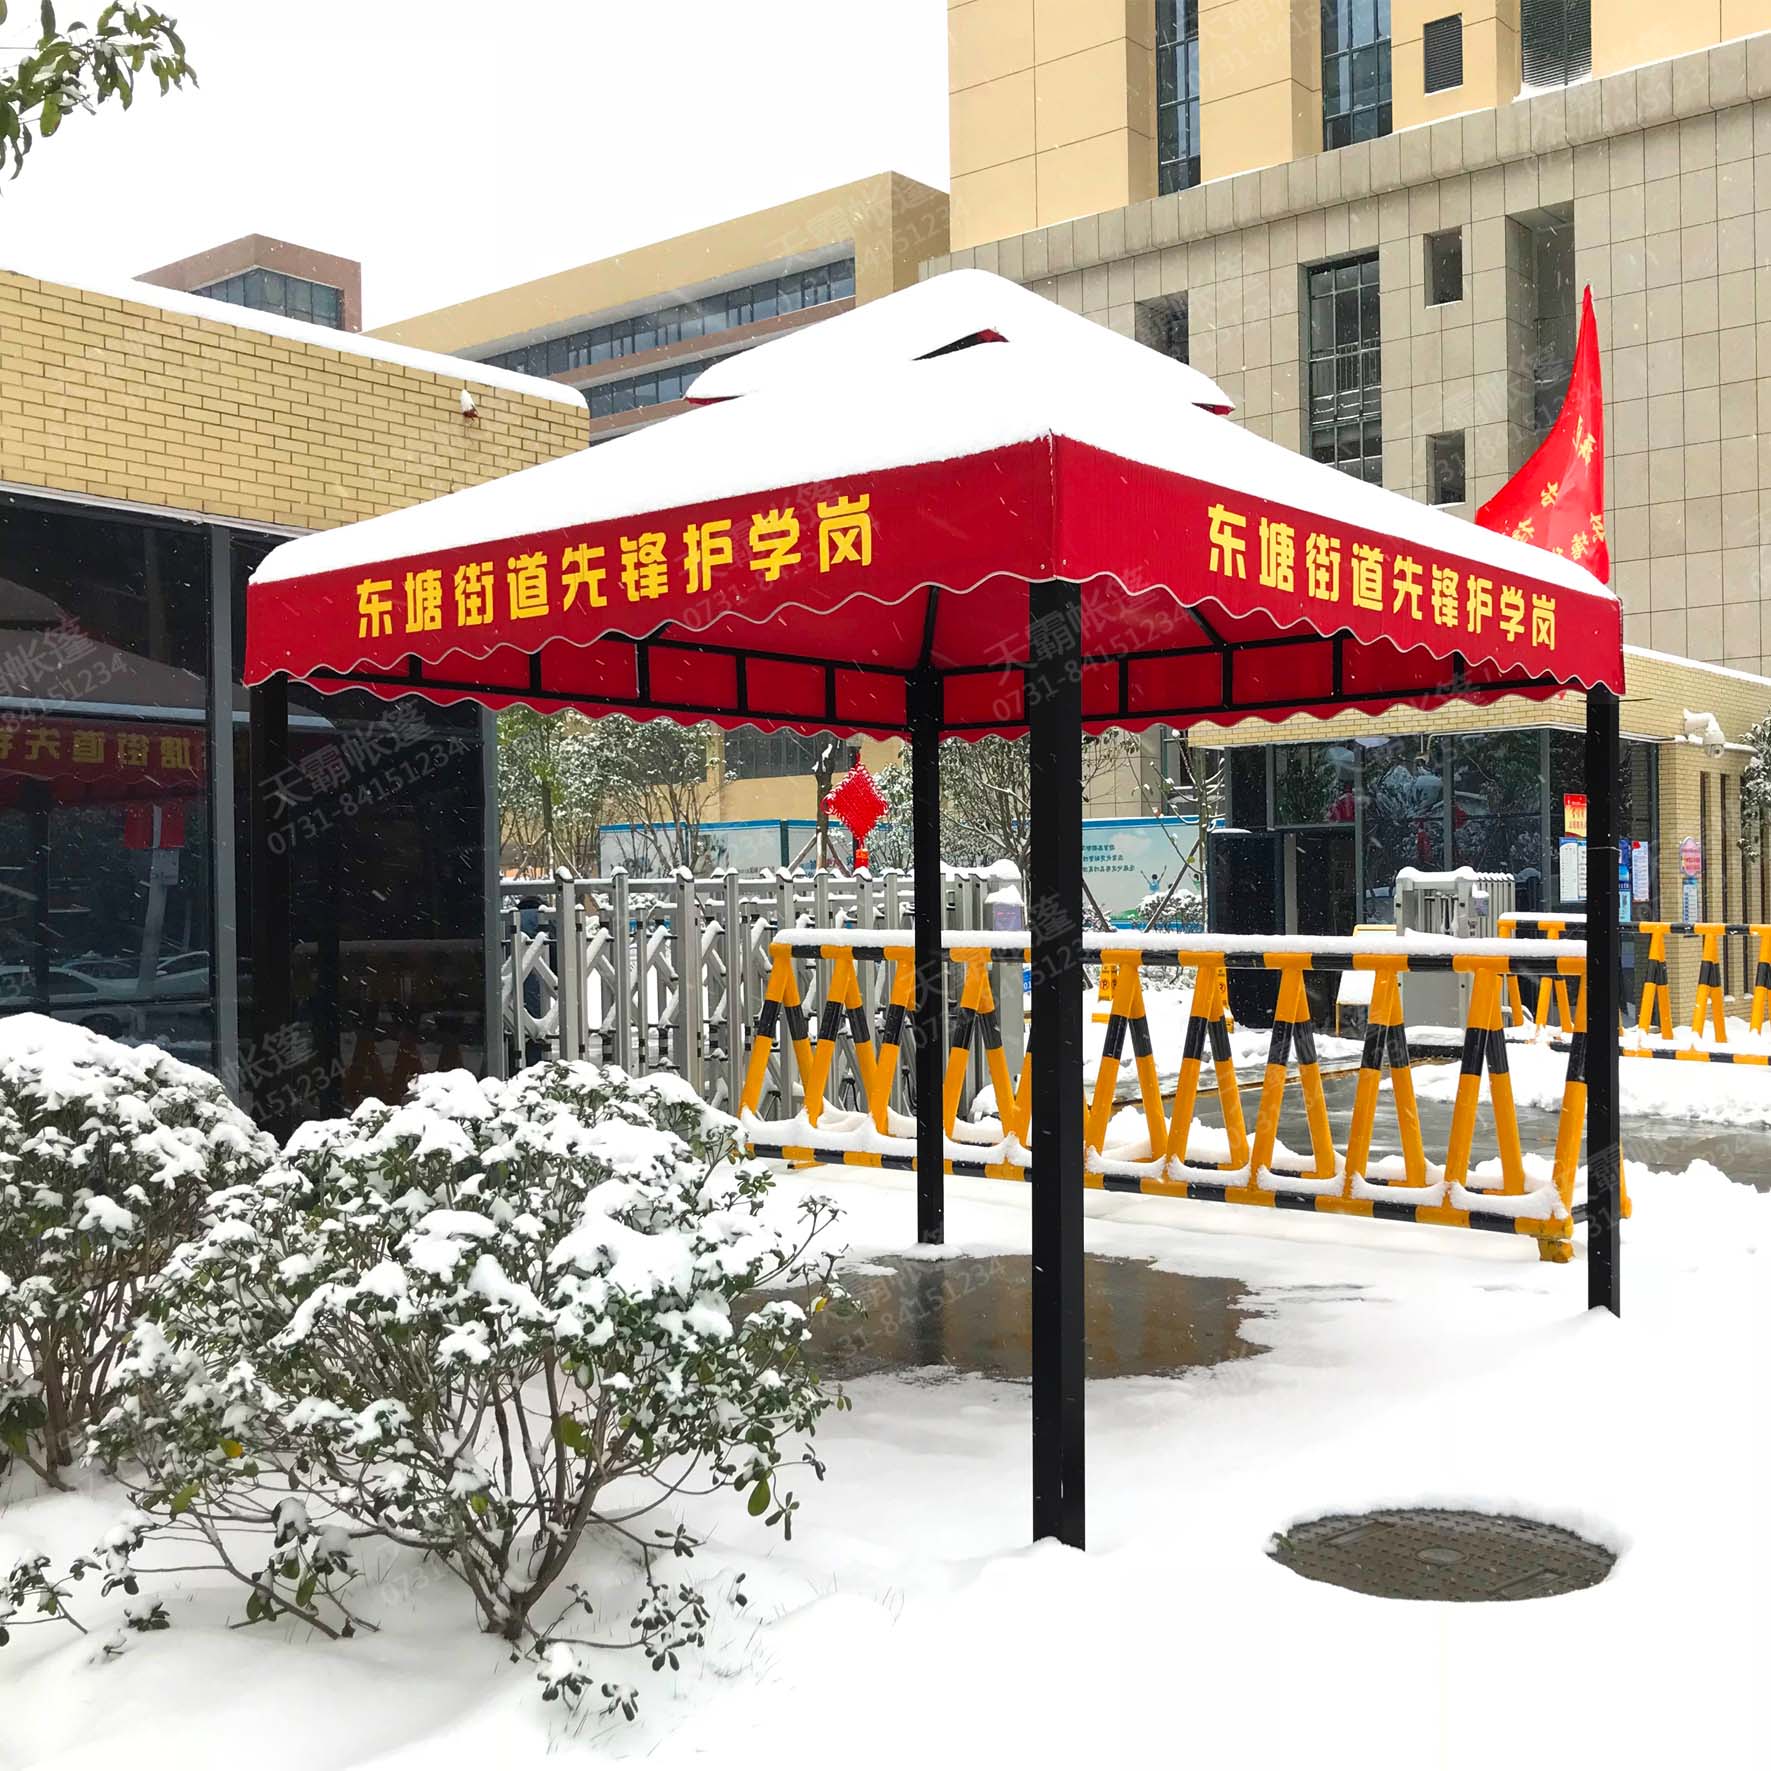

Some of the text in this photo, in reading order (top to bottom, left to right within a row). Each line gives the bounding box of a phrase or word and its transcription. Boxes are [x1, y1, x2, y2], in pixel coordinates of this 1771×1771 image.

[356, 494, 873, 639] 东塘街道先锋护学岗
[1208, 504, 1556, 651] 东塘街道先锋护学岗
